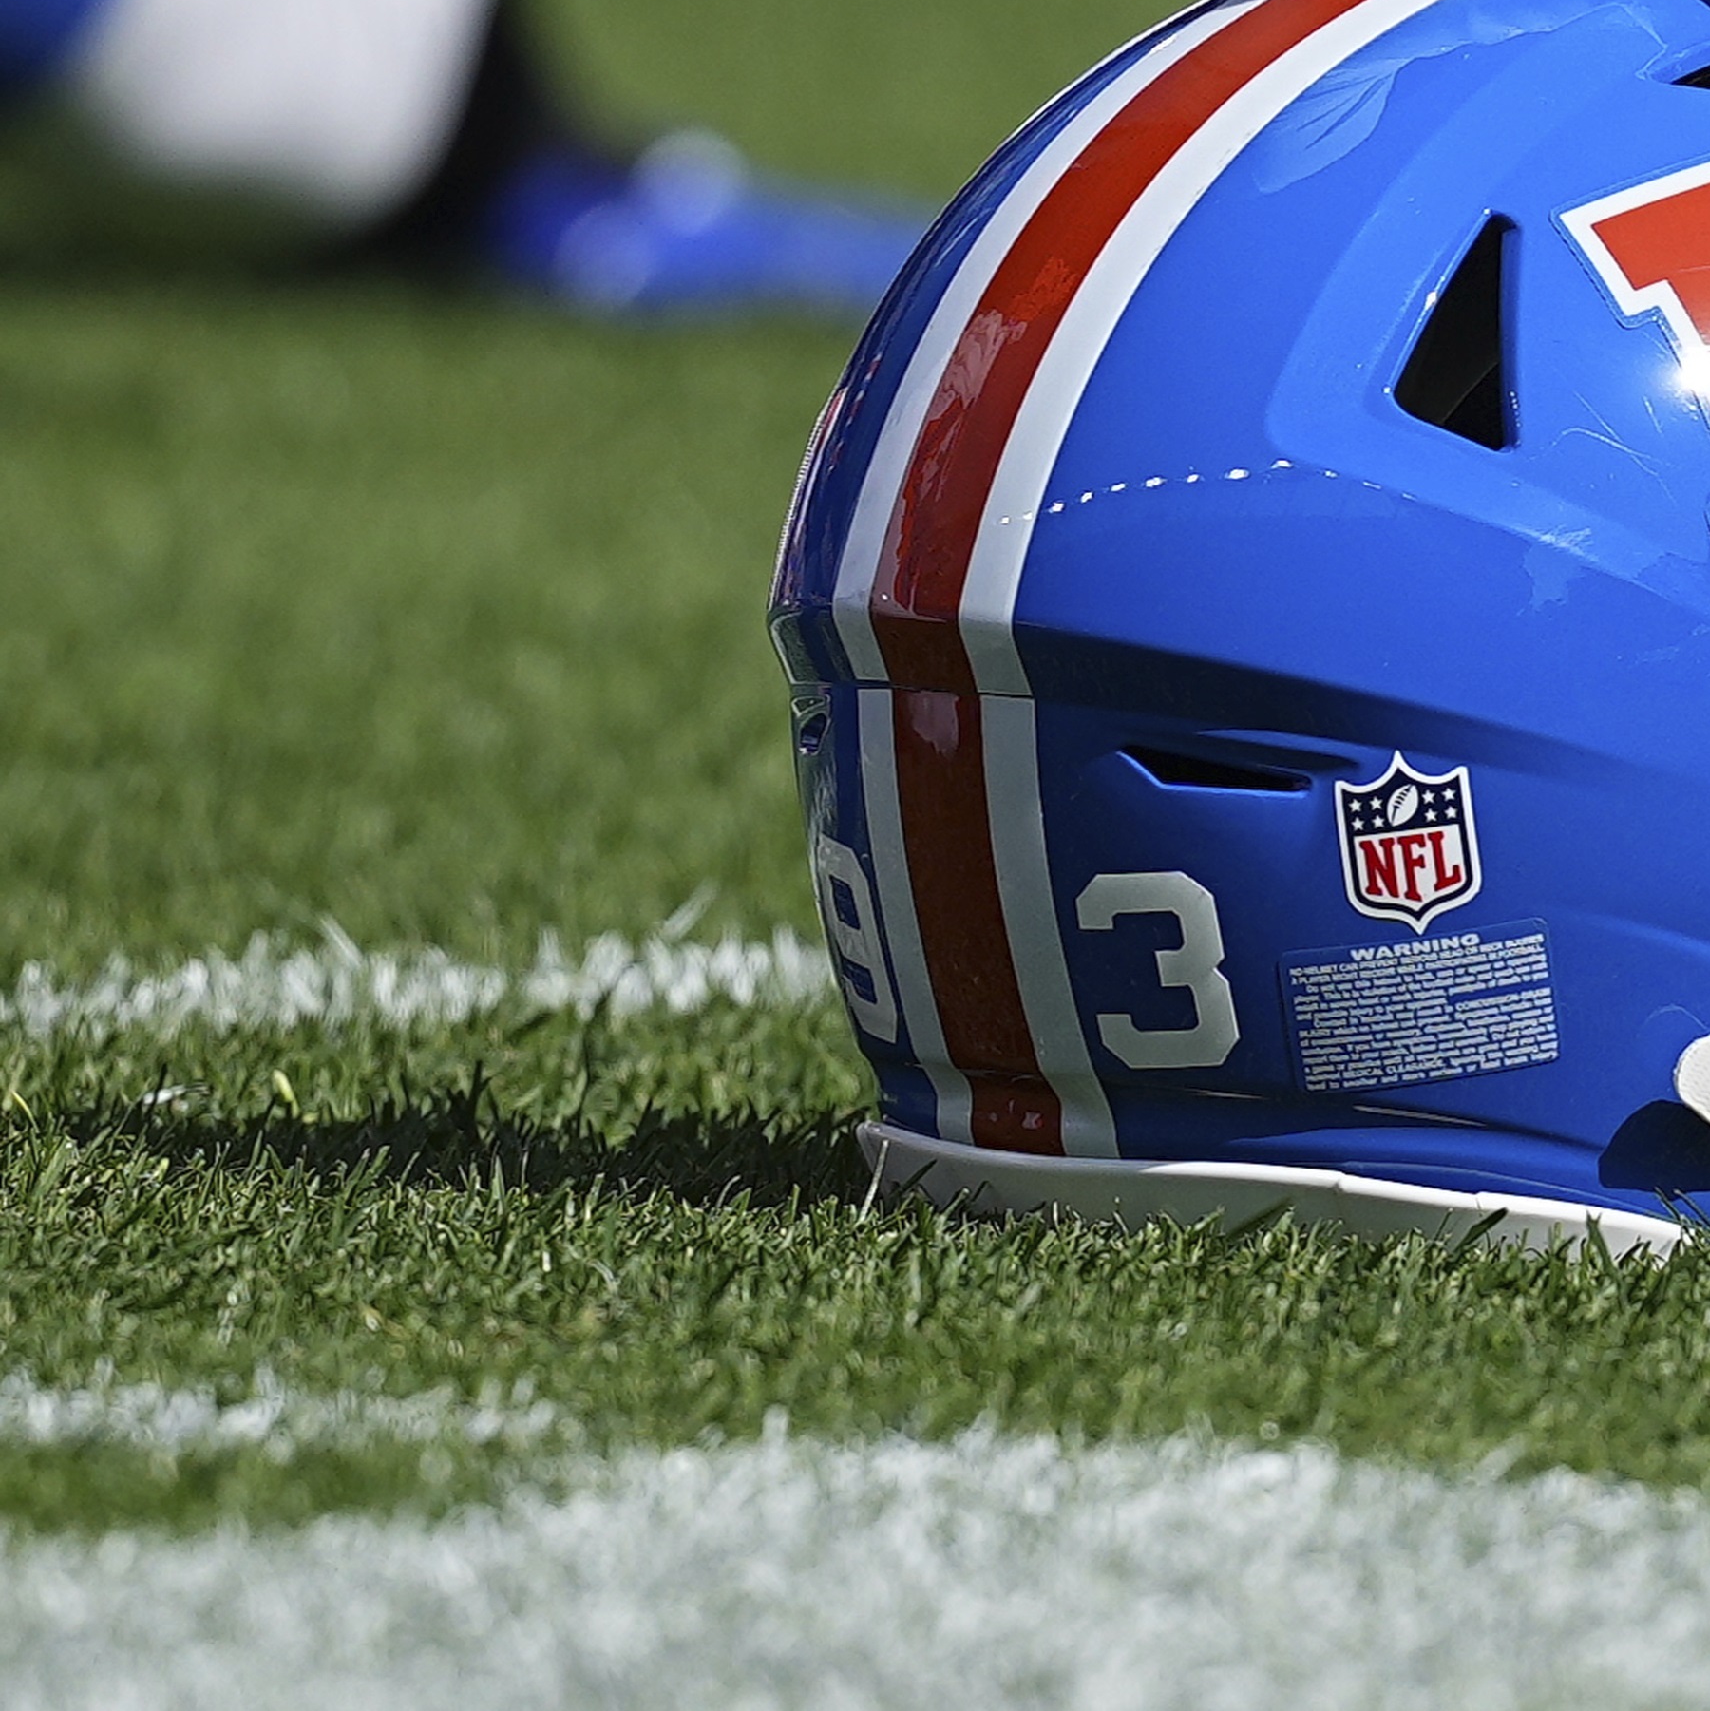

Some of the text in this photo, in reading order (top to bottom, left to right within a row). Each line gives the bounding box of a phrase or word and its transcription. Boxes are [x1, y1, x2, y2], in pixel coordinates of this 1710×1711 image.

[1359, 831, 1461, 902] NFL
[1076, 871, 1240, 1069] 3
[1350, 933, 1480, 961] WARNING
